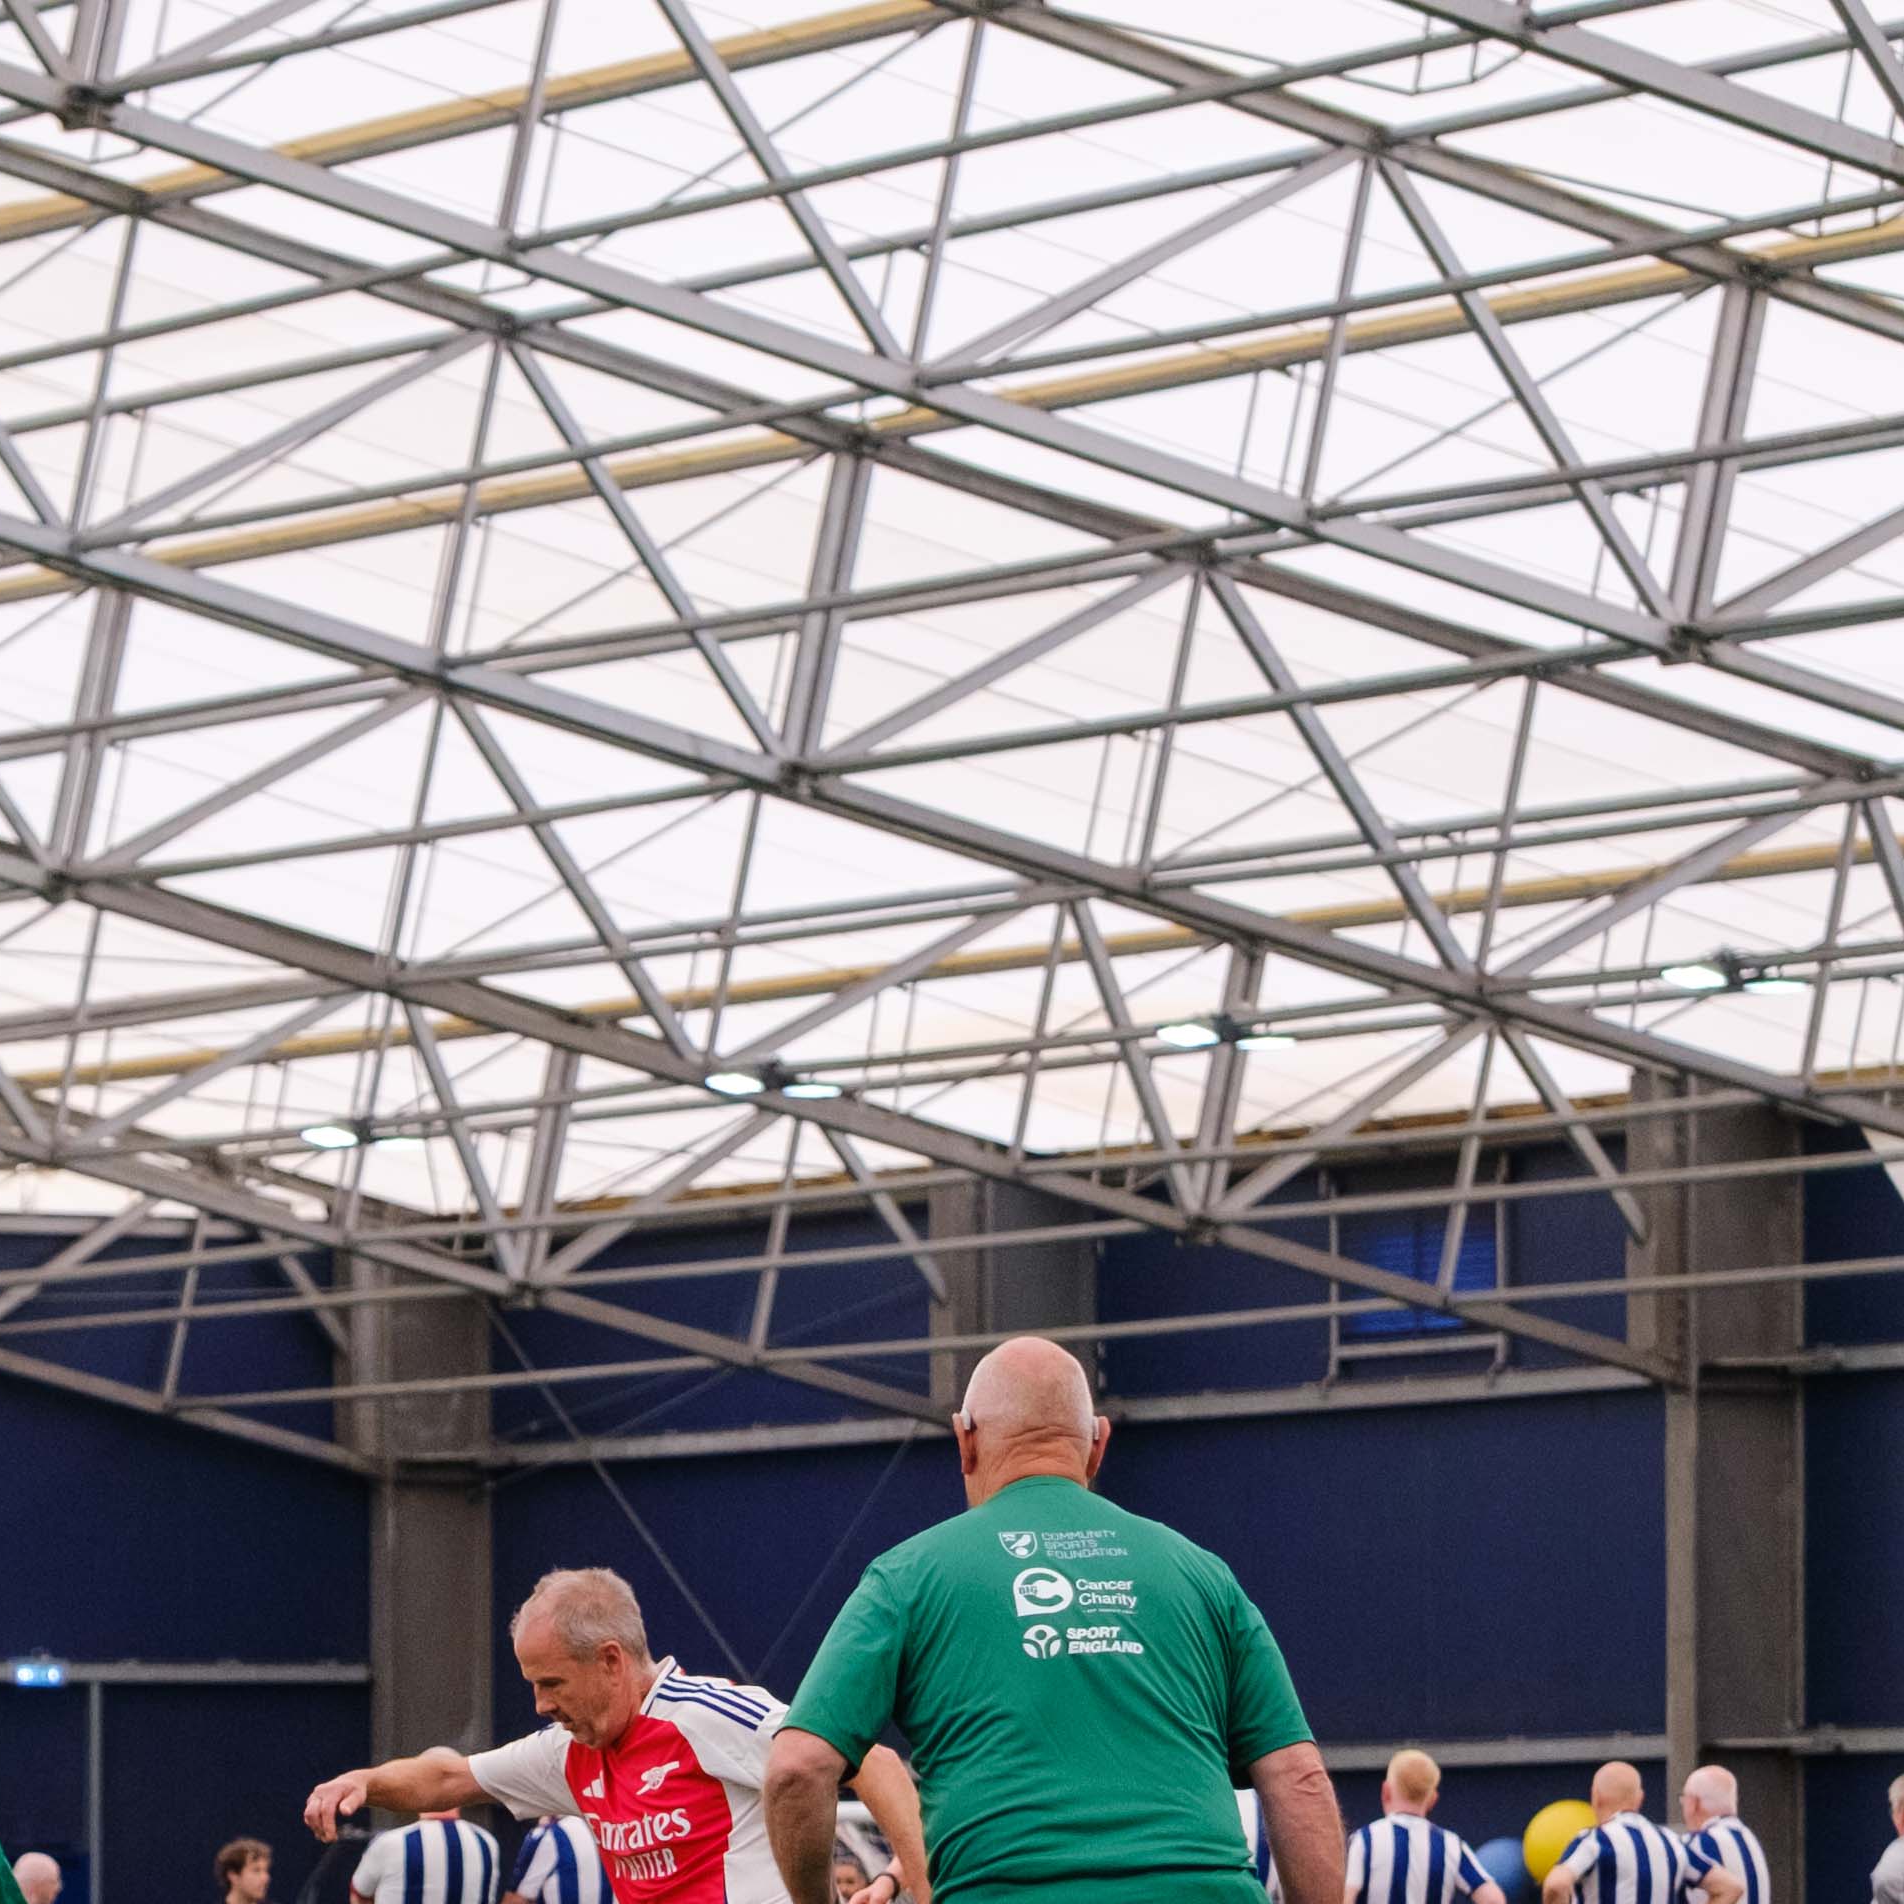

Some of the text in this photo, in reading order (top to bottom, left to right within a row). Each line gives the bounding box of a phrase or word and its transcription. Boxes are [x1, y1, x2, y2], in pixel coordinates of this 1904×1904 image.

[1041, 1530, 1116, 1541] COMMUNITY
[1044, 1539, 1098, 1550] SPORTS
[1046, 1548, 1128, 1560] FOUNDATION
[1076, 1579, 1134, 1591] Cancer
[1079, 1592, 1137, 1609] Charity
[1066, 1626, 1121, 1640] SPORT
[1068, 1641, 1144, 1654] ENGLAND
